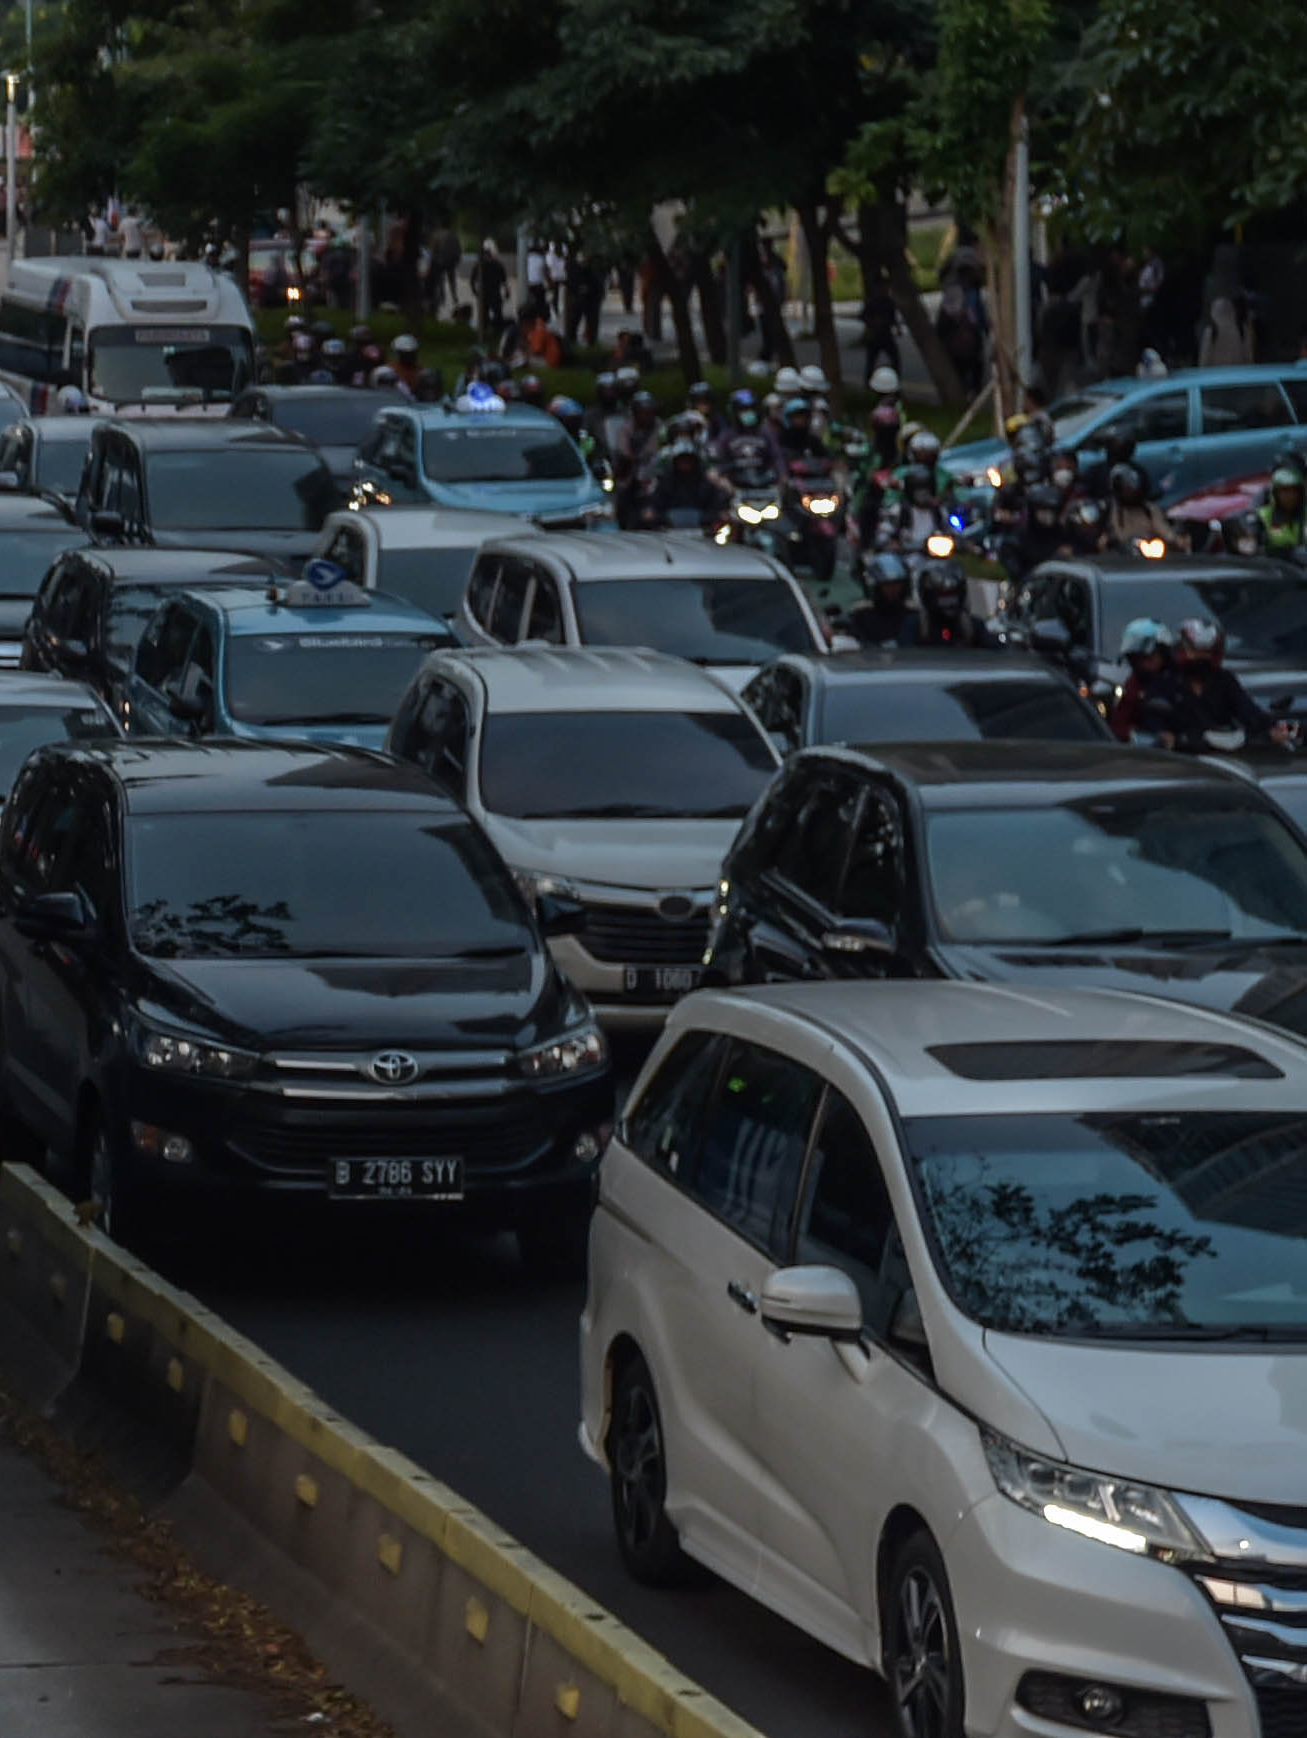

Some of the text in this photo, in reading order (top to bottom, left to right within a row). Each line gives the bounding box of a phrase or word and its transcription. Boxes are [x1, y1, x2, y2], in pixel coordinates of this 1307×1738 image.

[335, 1160, 459, 1185] B 2786 SYY
